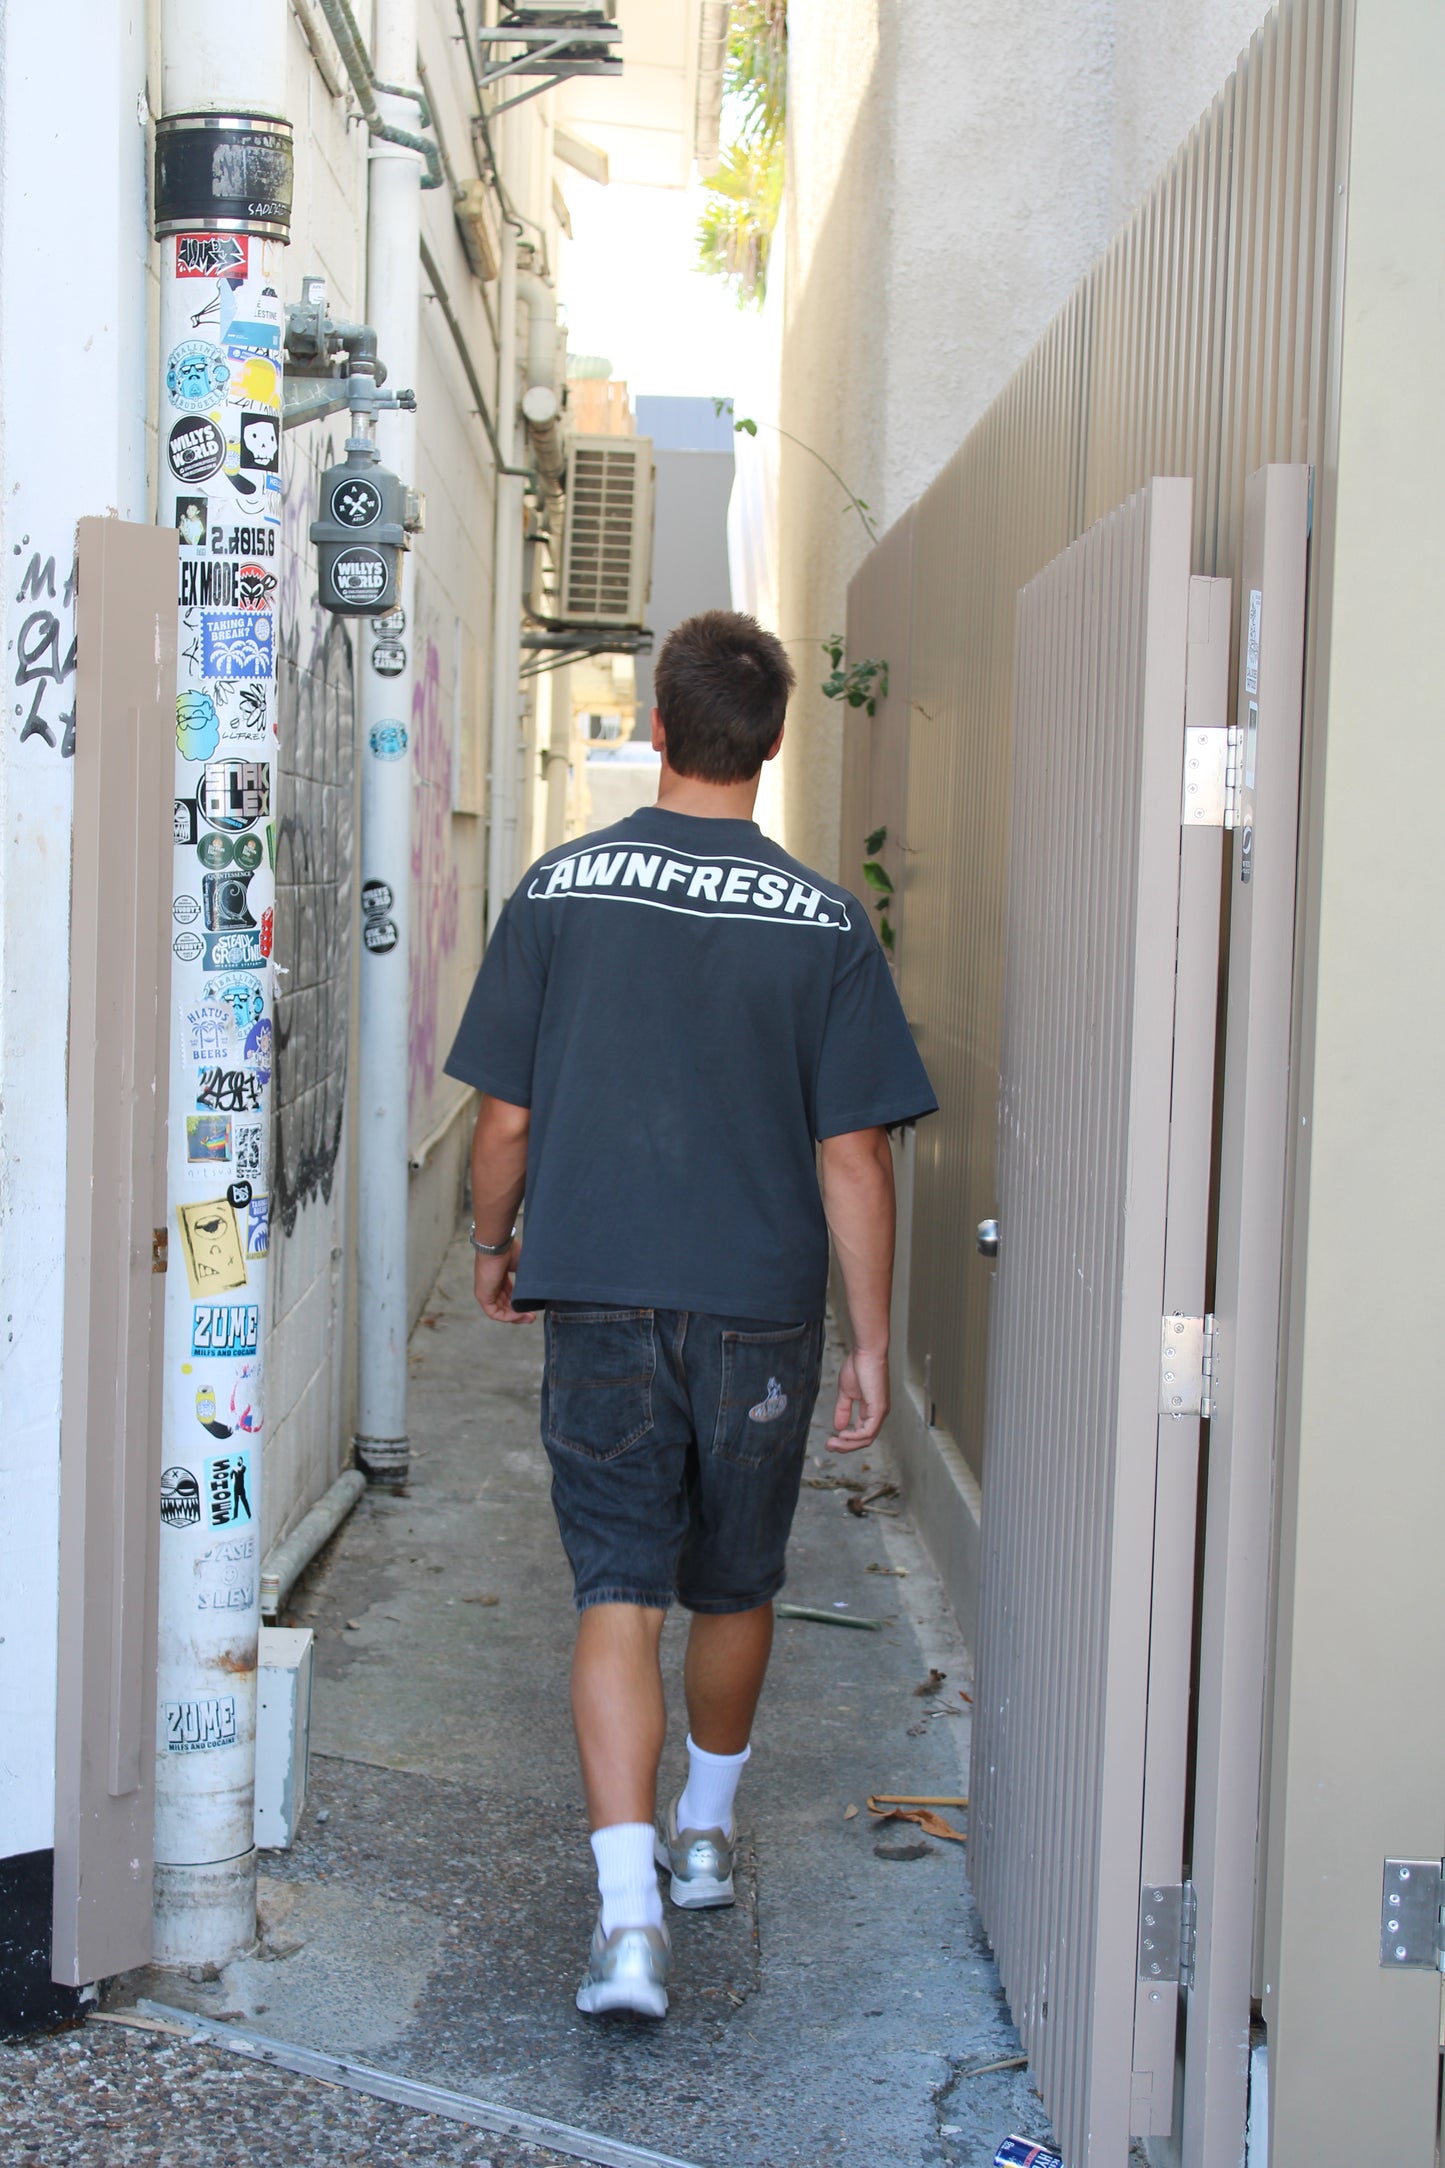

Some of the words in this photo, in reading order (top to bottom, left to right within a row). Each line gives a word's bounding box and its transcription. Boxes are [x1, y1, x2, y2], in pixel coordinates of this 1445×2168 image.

[179, 396, 214, 410] BUDGET
[170, 425, 215, 454] WILLYS
[172, 440, 219, 469] WORLD
[338, 562, 382, 575] WILLYS
[338, 575, 384, 589] WORLD
[207, 618, 245, 632] TAKING
[246, 617, 253, 627] A
[211, 628, 250, 641] BREAK?
[218, 934, 254, 949] STEADY
[212, 944, 261, 964] GROUND
[187, 1007, 230, 1023] HIATUS
[193, 1048, 228, 1060] BEERS
[233, 1348, 257, 1356] COCAINE
[190, 1741, 206, 1750] AND
[207, 1737, 235, 1748] COCAINE
